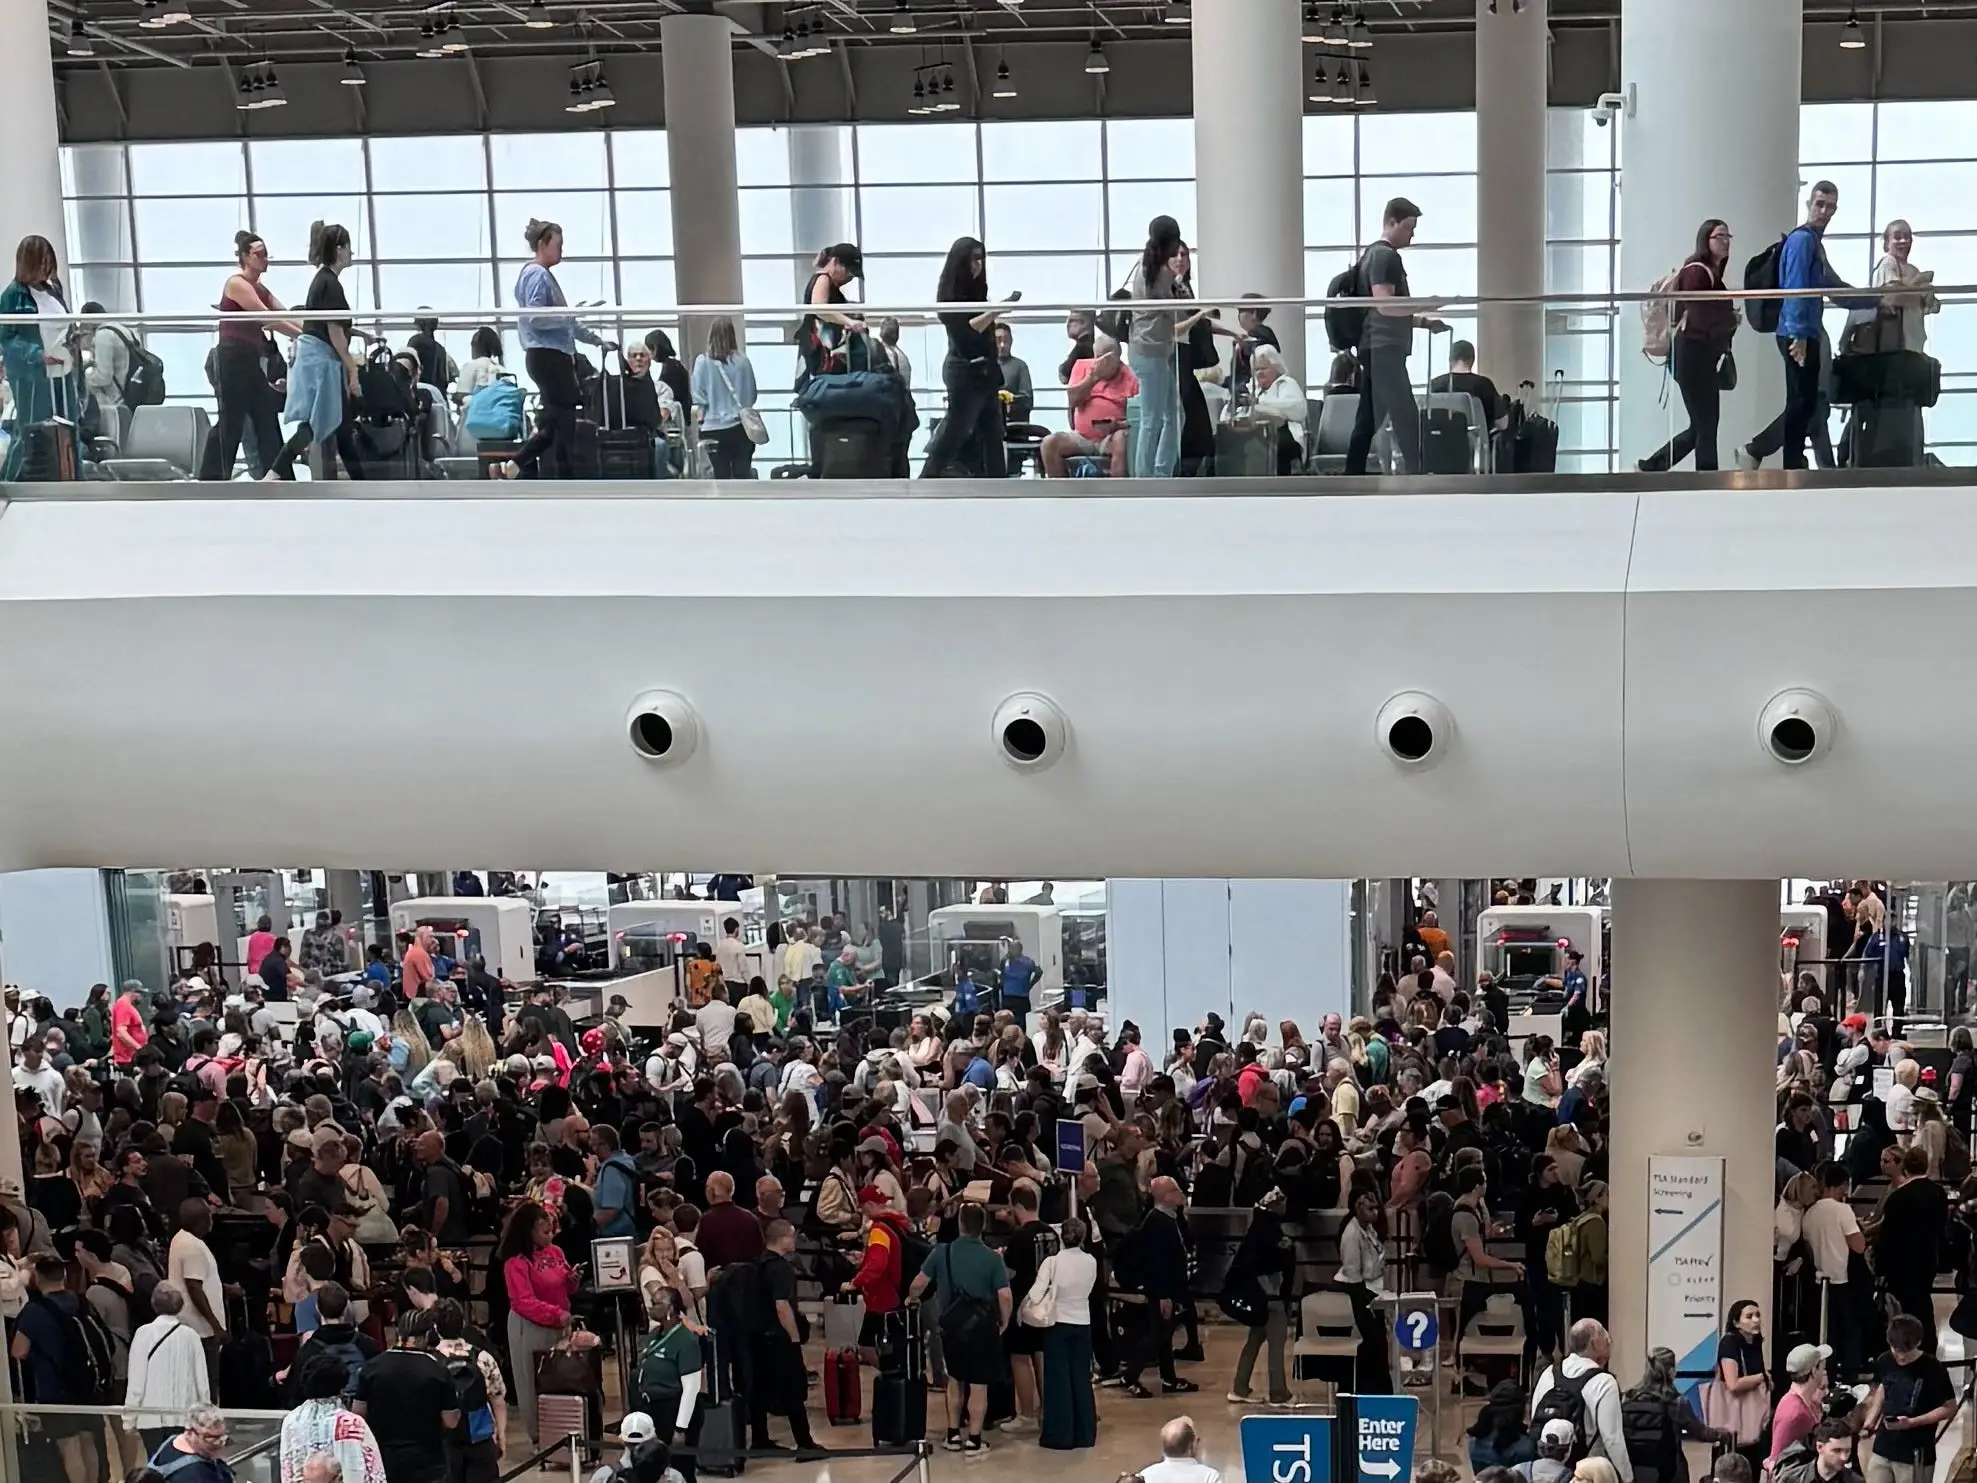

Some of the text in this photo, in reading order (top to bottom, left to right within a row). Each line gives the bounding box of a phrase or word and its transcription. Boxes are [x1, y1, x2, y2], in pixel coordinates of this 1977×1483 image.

[1406, 1311, 1429, 1348] ?
[1358, 1418, 1405, 1434] Enter
[1358, 1435, 1400, 1451] Here
[1272, 1434, 1311, 1483] TS
